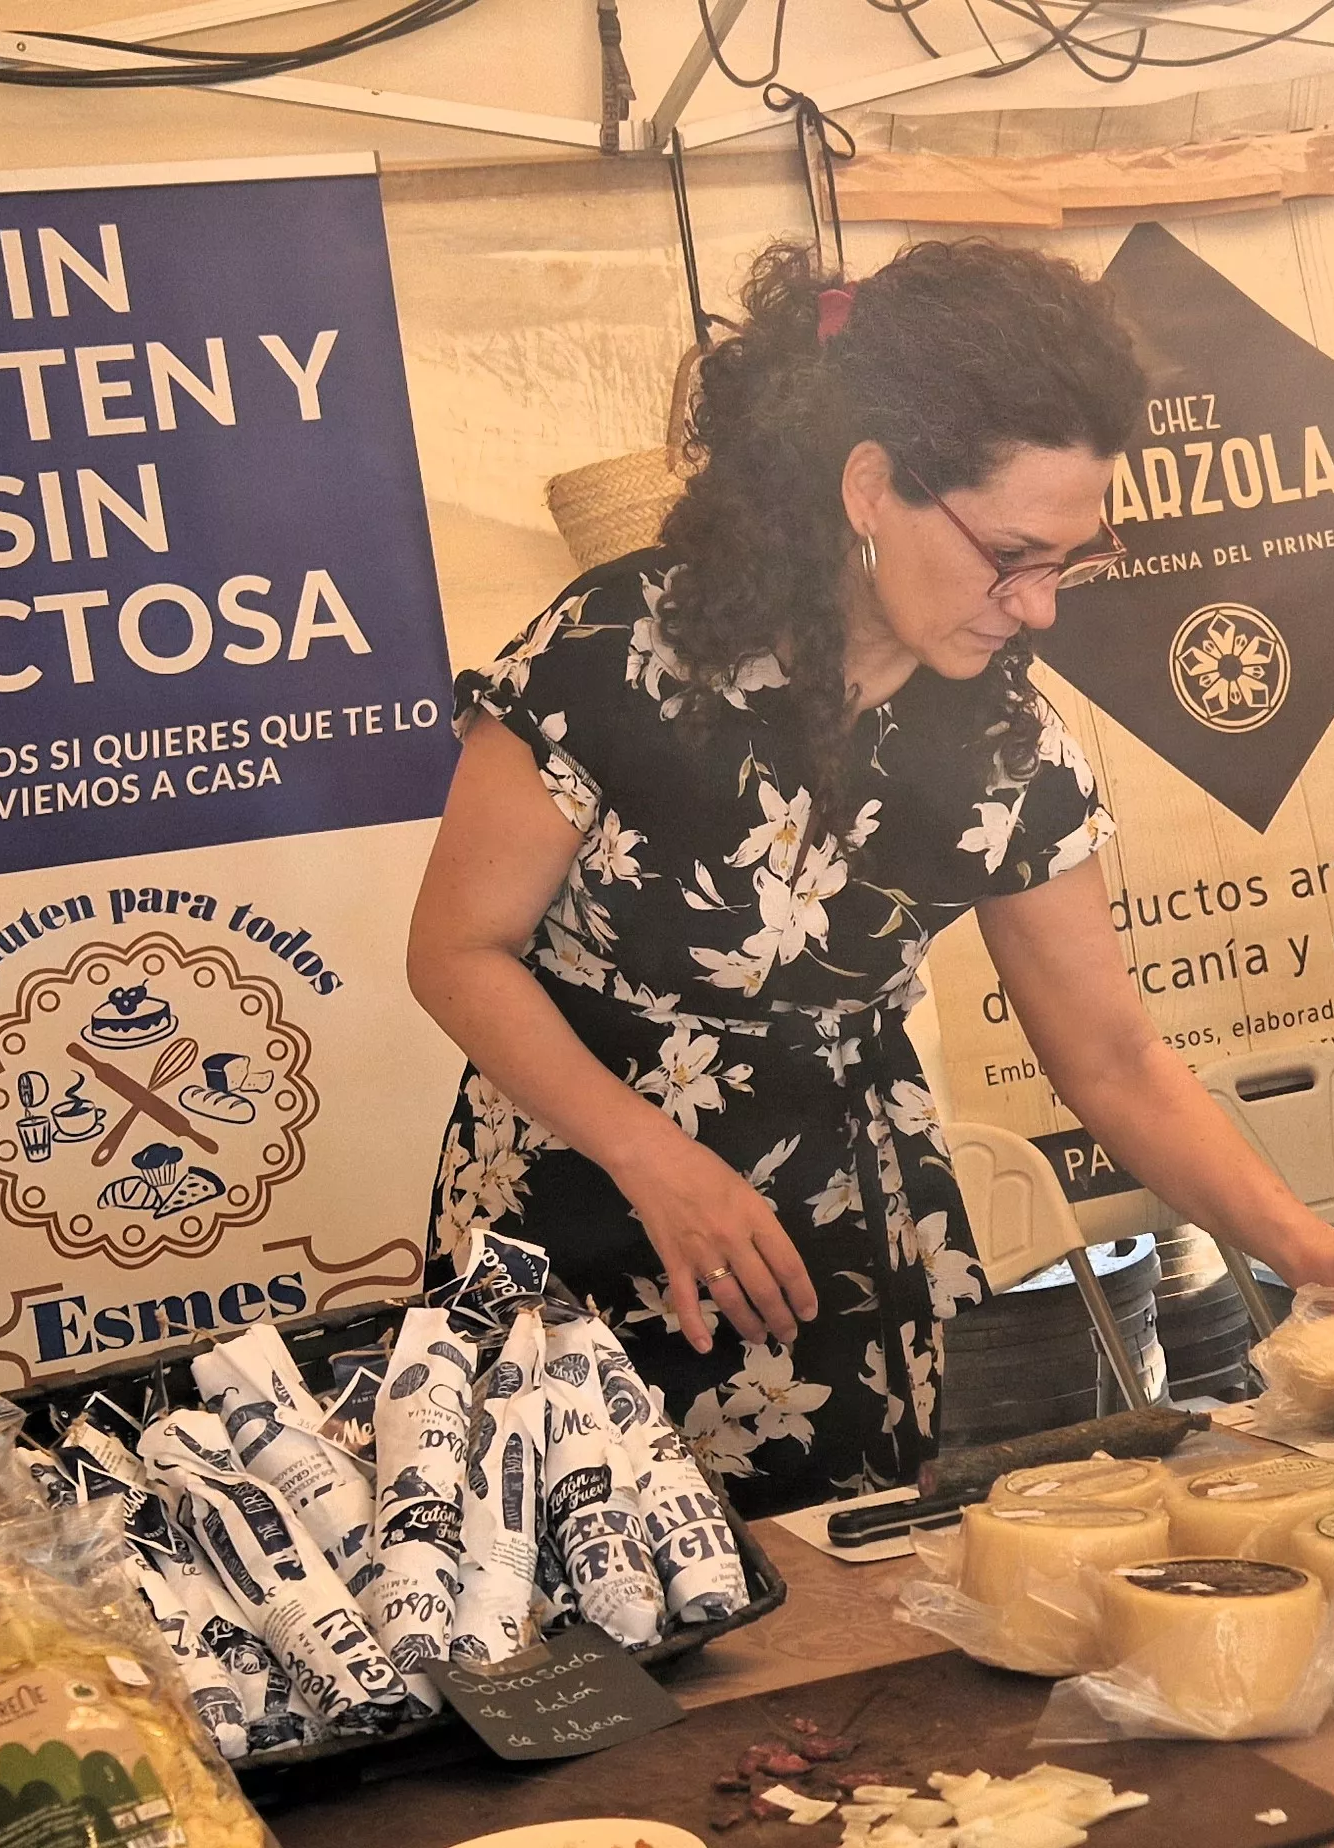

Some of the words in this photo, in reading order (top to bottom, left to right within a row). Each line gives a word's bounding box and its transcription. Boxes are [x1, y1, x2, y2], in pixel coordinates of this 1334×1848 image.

[258, 331, 339, 421] Y
[1148, 394, 1221, 436] CHEZ
[1107, 551, 1203, 581] ALACENA
[1214, 544, 1252, 567] DEL
[51, 739, 80, 771] SI
[93, 720, 250, 767] QUIERES
[259, 710, 330, 748] QUE
[343, 704, 384, 738] TE
[393, 698, 438, 731] LO
[151, 769, 176, 800] A
[187, 757, 283, 795] CASA
[1110, 872, 1269, 932] ductos
[107, 887, 218, 924] para
[228, 903, 344, 996] todos
[1128, 936, 1270, 994] canía
[1288, 929, 1312, 978] y
[1162, 1027, 1221, 1050] esos,
[28, 1270, 309, 1365] Esmes
[279, 1468, 310, 1495] GRAUS
[405, 1505, 456, 1529] Latón
[447, 1652, 607, 1695] Sobrasada
